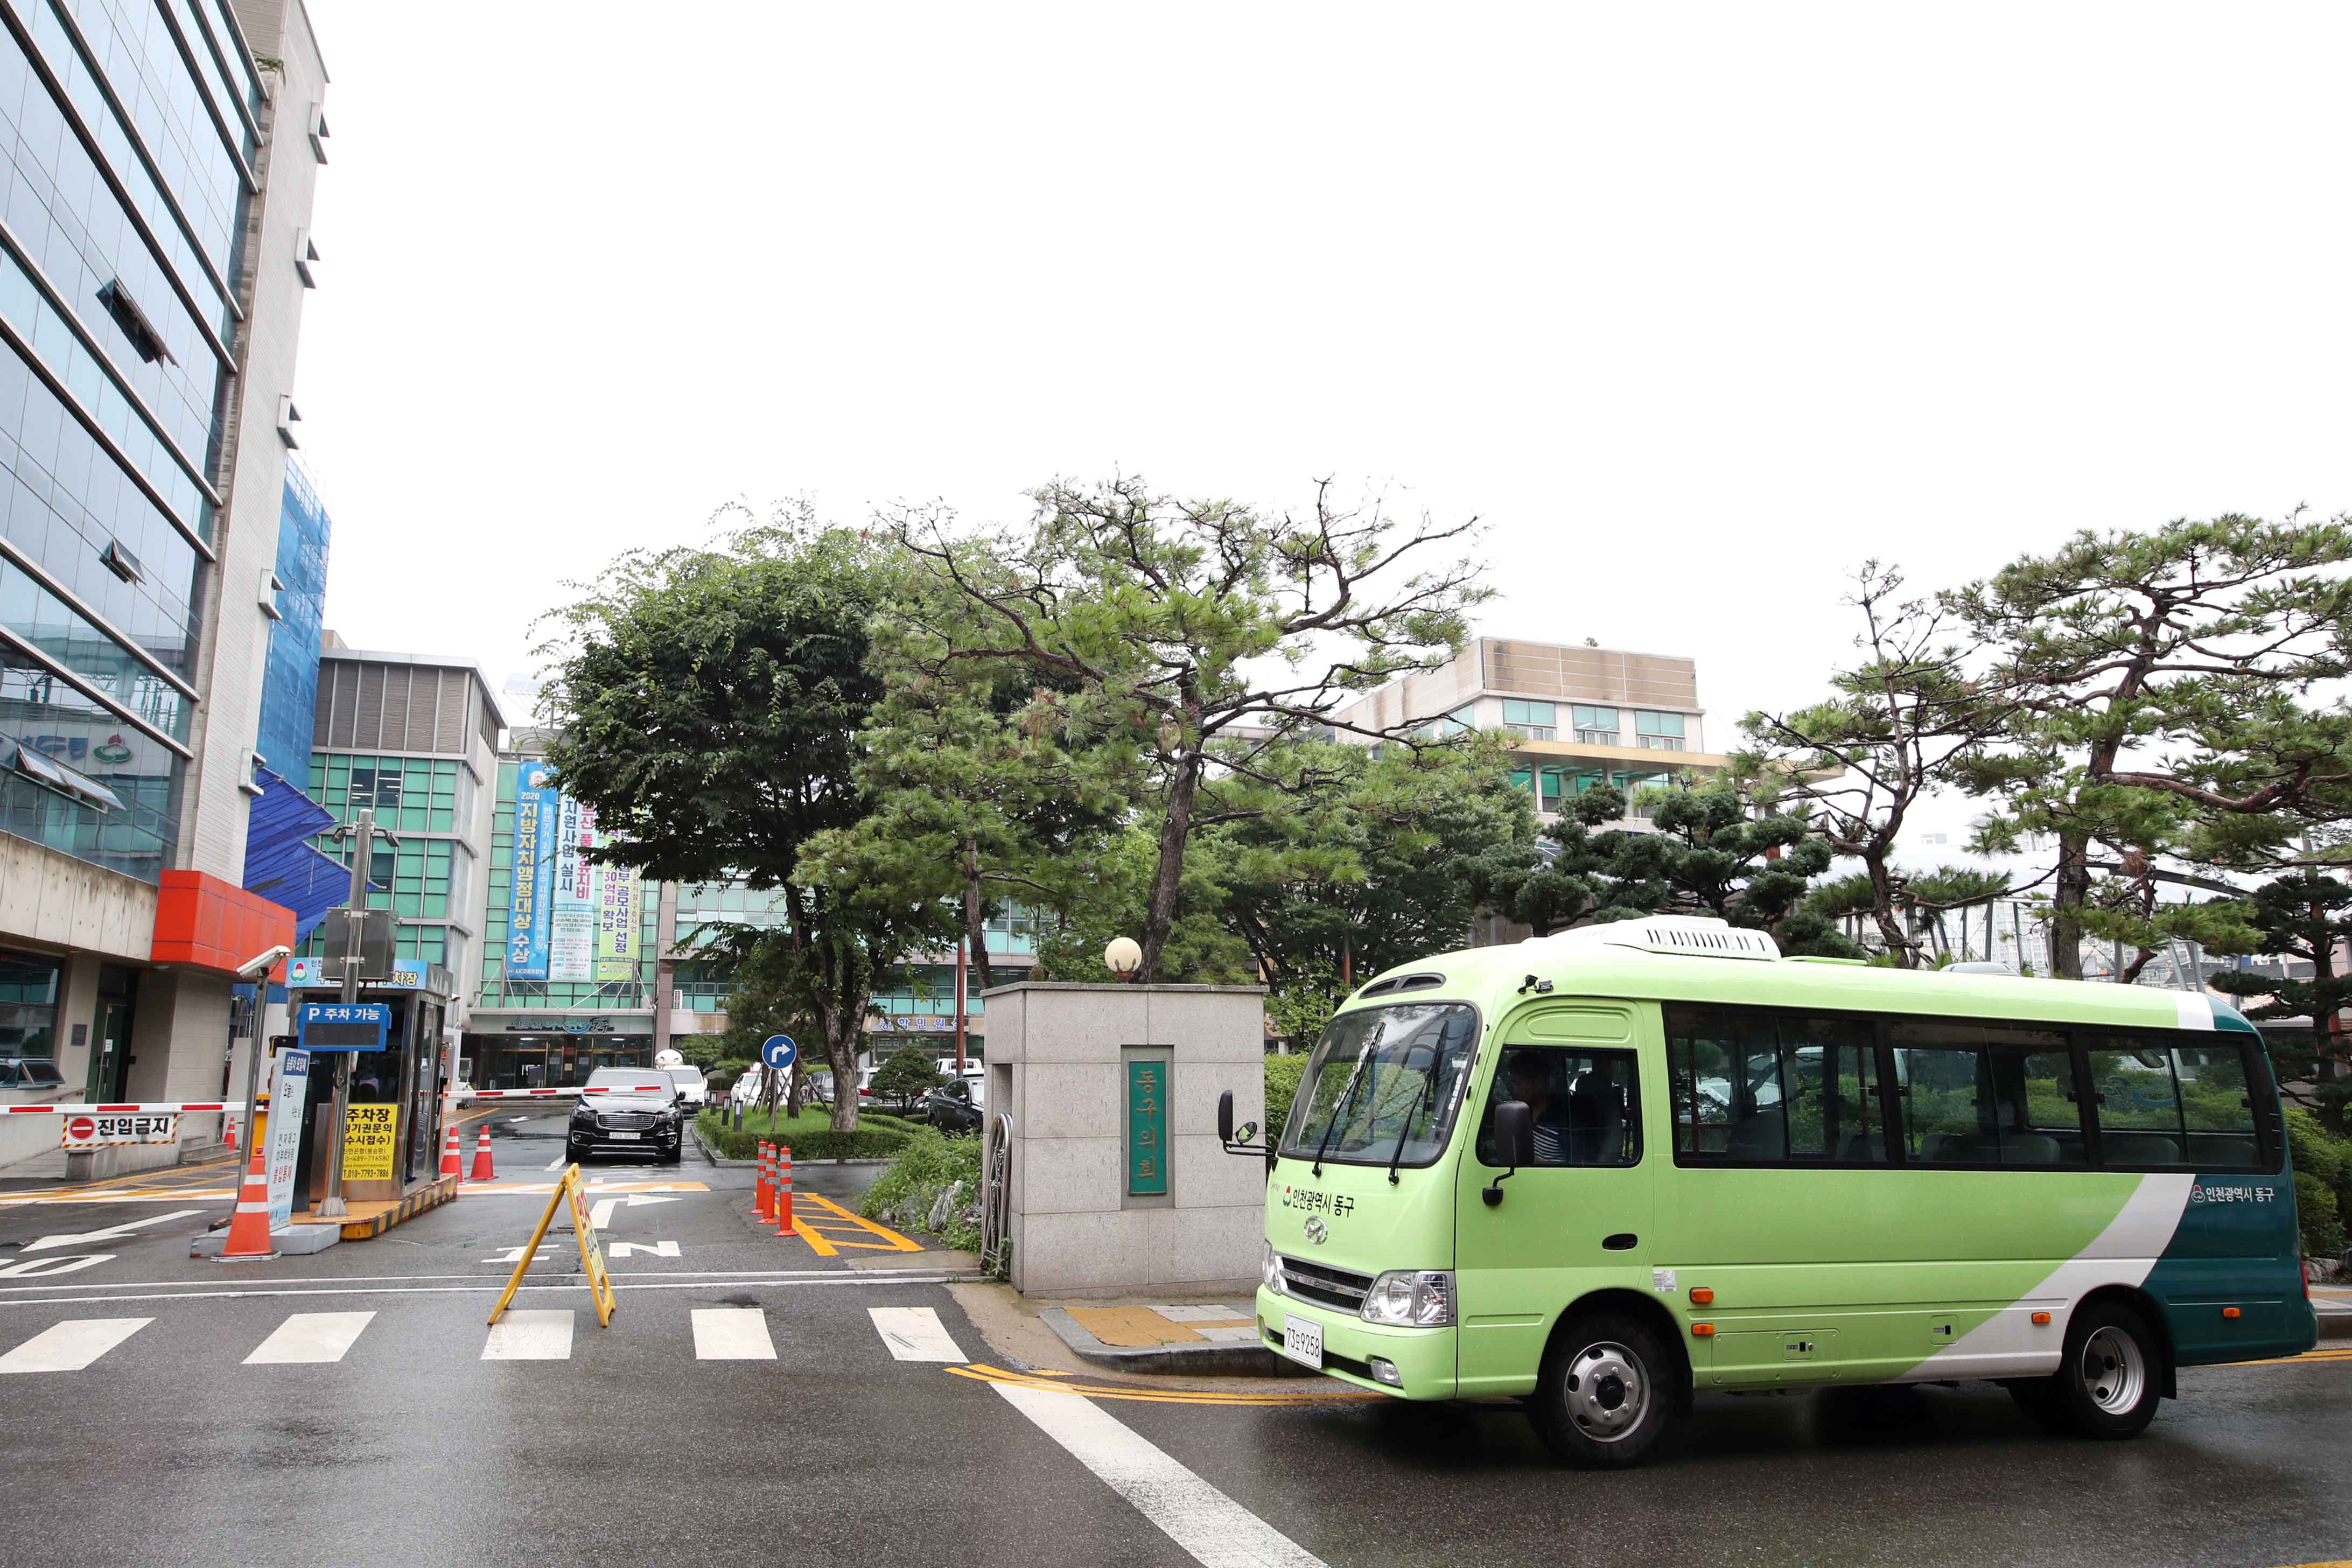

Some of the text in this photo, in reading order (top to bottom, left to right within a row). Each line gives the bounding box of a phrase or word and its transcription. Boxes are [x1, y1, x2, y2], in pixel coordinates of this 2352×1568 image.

[521, 792, 540, 801] 2020
[559, 800, 578, 892] 지원사업 실시
[514, 803, 538, 930] 지방자치행정대상
[576, 834, 593, 900] 품유지비
[616, 885, 630, 929] 공모사업
[602, 910, 615, 932] 확보
[512, 932, 530, 964] 수상
[614, 932, 627, 954] 선정
[308, 1007, 320, 1021] P
[324, 1008, 381, 1021] 주차 가능
[97, 1117, 169, 1136] 진입금지
[347, 1108, 390, 1122] 주차장
[1135, 1069, 1158, 1183] 동구의회
[1293, 1188, 1354, 1218] 인천광역시 동구
[2206, 1187, 2275, 1202] 인천광역시 동구
[1287, 1327, 1320, 1357] 73모9258
